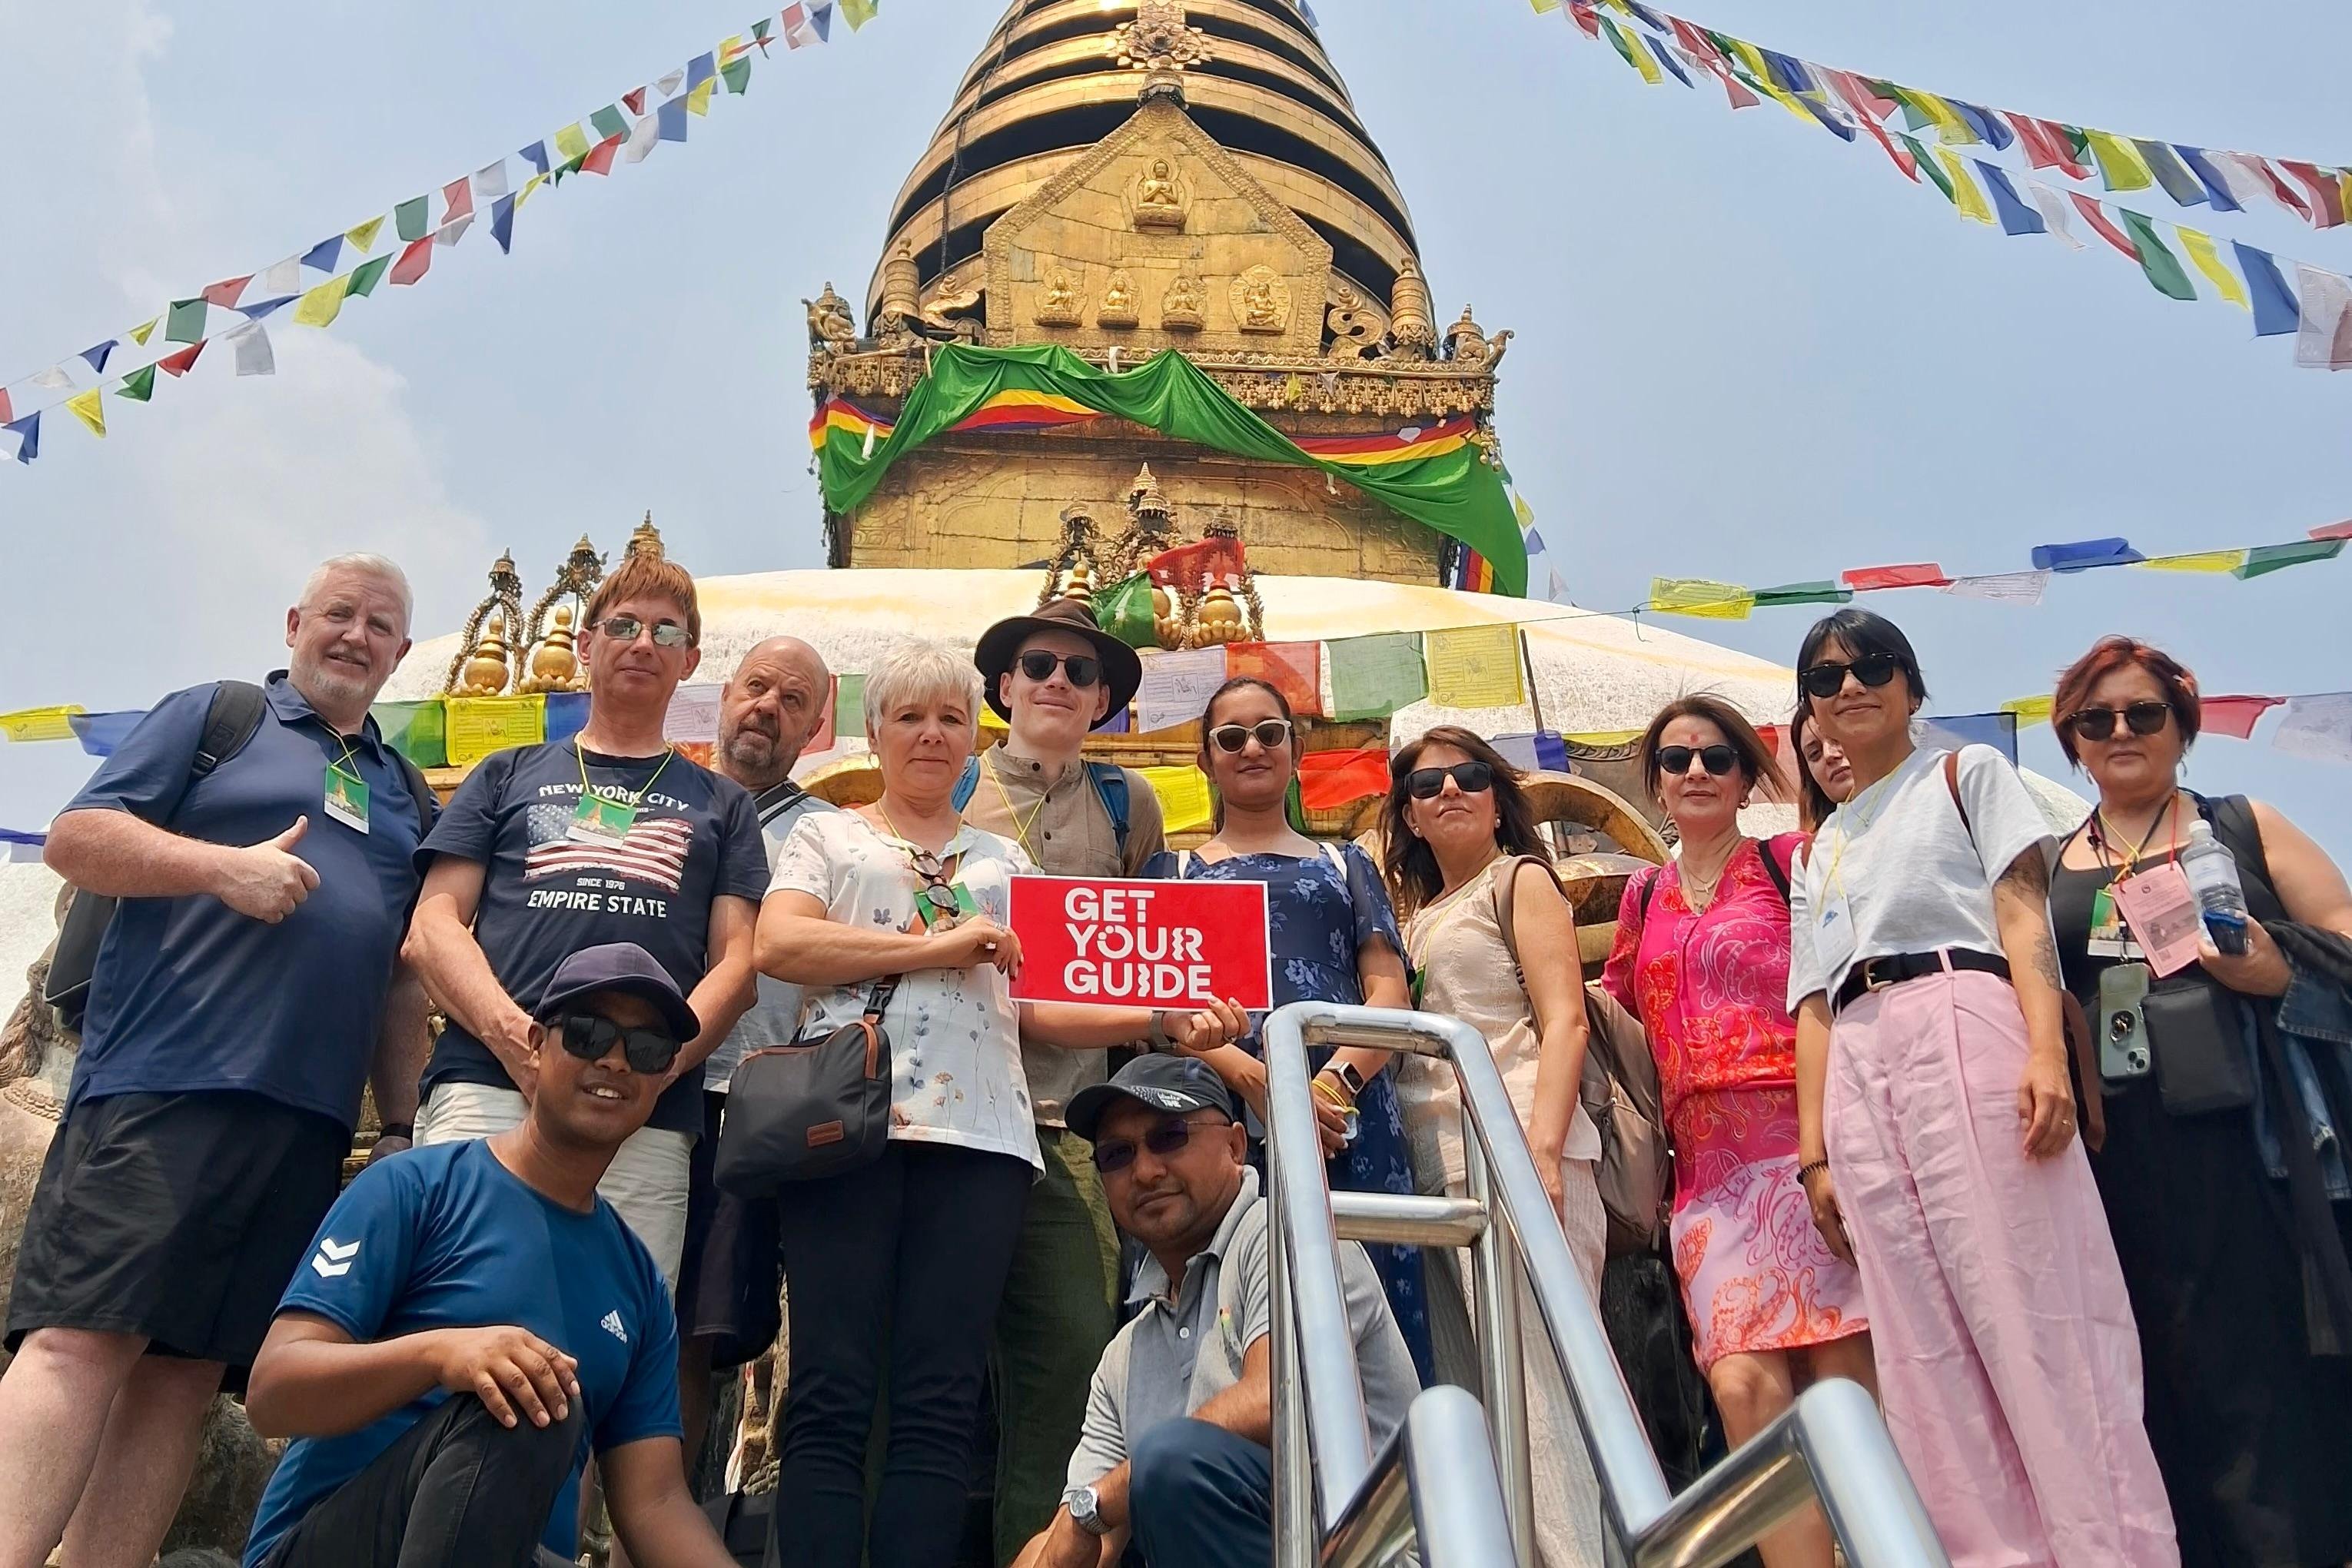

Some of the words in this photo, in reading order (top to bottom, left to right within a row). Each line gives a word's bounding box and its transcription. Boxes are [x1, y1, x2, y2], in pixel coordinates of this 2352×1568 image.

[539, 782, 584, 797] NEW
[590, 784, 641, 804] YORK
[647, 792, 689, 812] CITY
[576, 877, 603, 889] SINCE
[527, 890, 603, 911] EMPIRE
[606, 895, 667, 918] STATE
[1065, 887, 1155, 923] GET
[1065, 922, 1204, 961] YOUR
[1064, 959, 1212, 999] GUIDE
[600, 1319, 628, 1344] adidas
